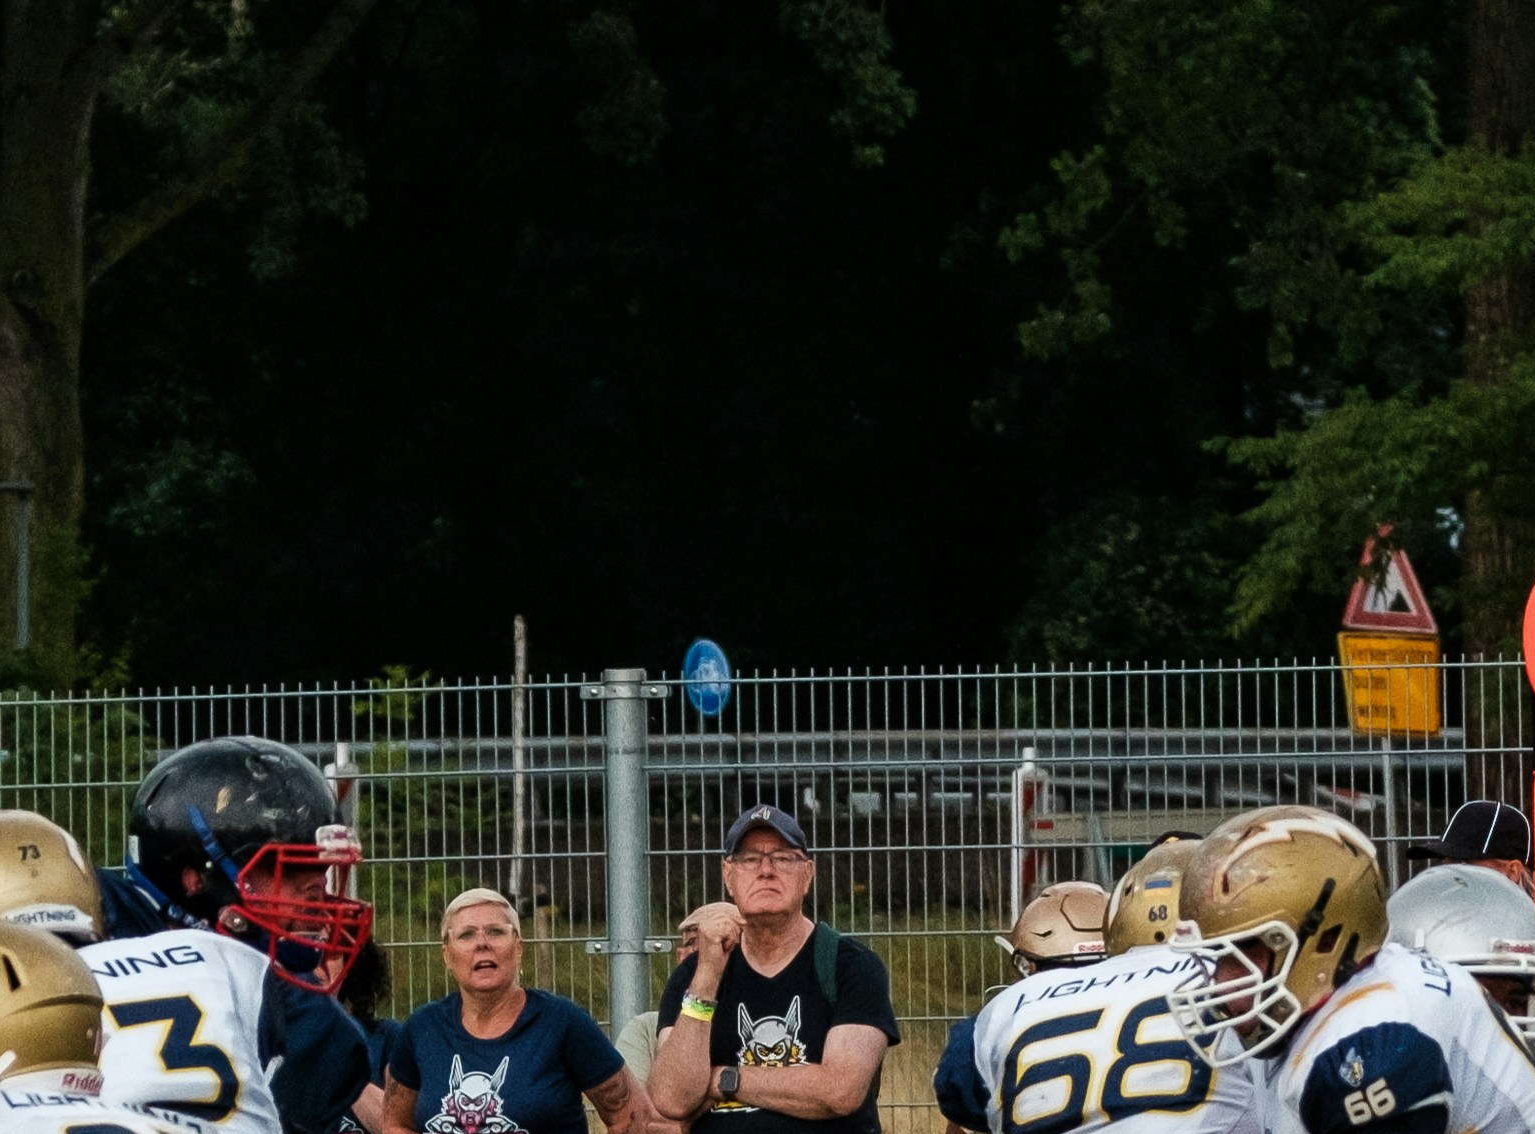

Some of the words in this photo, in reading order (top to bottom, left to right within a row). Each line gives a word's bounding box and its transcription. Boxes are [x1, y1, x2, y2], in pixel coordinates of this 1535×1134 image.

[18, 845, 42, 861] 73
[1149, 904, 1168, 922] 68
[1344, 1077, 1397, 1126] 66
